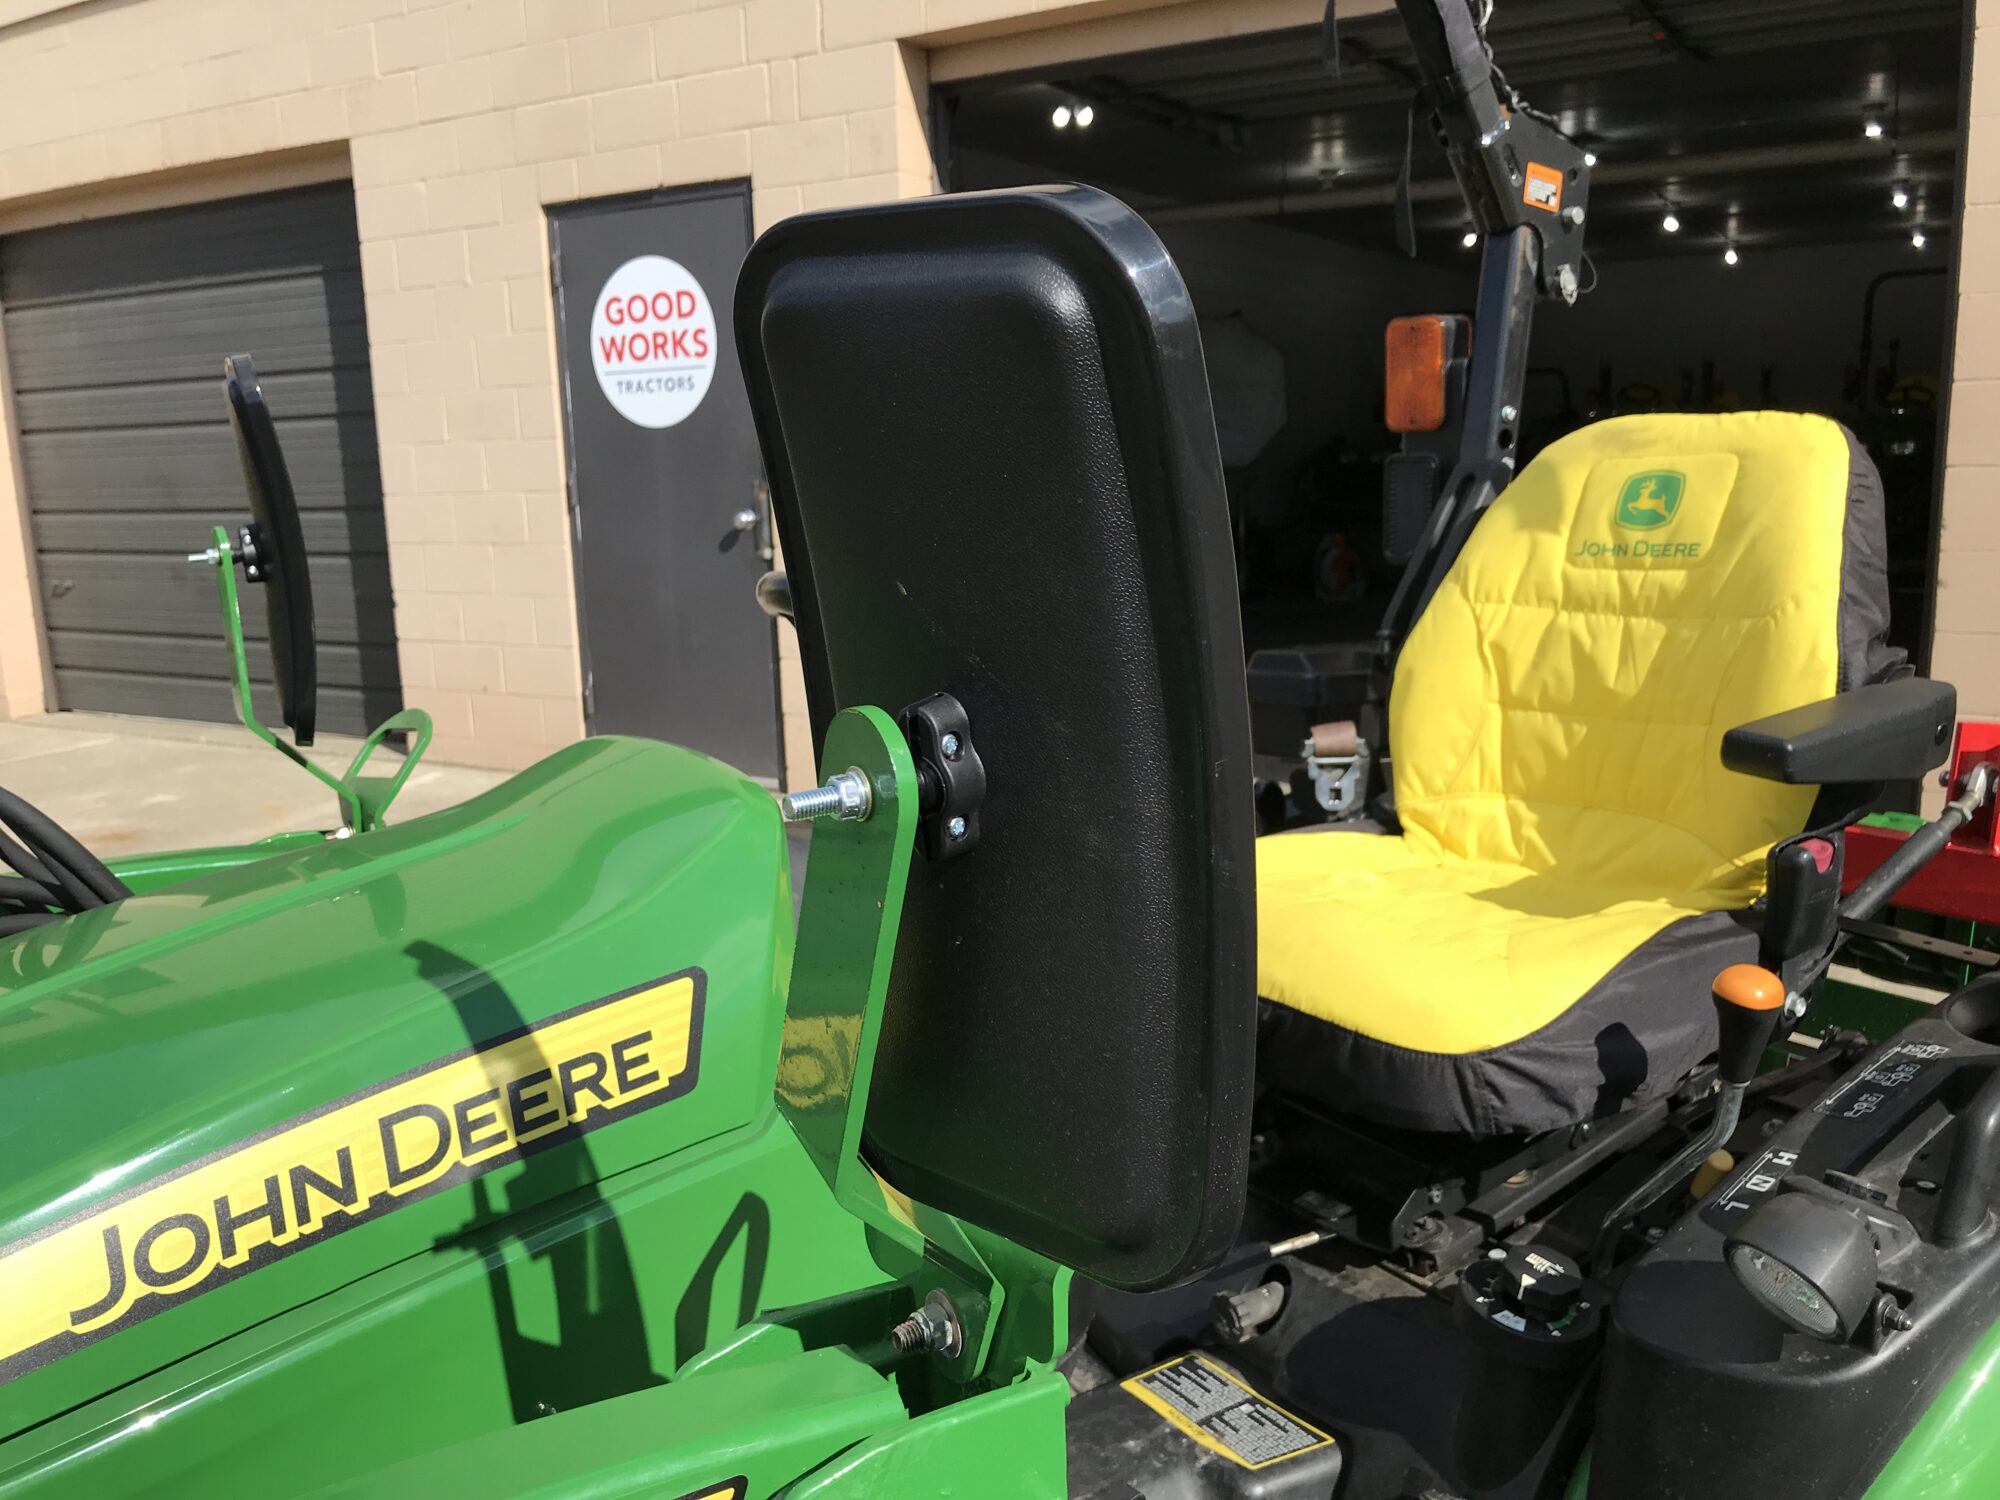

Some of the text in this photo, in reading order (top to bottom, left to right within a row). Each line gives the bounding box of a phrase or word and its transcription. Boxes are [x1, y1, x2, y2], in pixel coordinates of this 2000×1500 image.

[605, 290, 696, 326] GOOD
[599, 328, 709, 365] WORKS
[616, 376, 695, 394] TRACTORS
[1573, 540, 1701, 558] JOHN DEERE
[1772, 1151, 1798, 1166] H
[69, 1030, 660, 1327] JOHN DEERE
[1724, 1201, 1750, 1211] L
